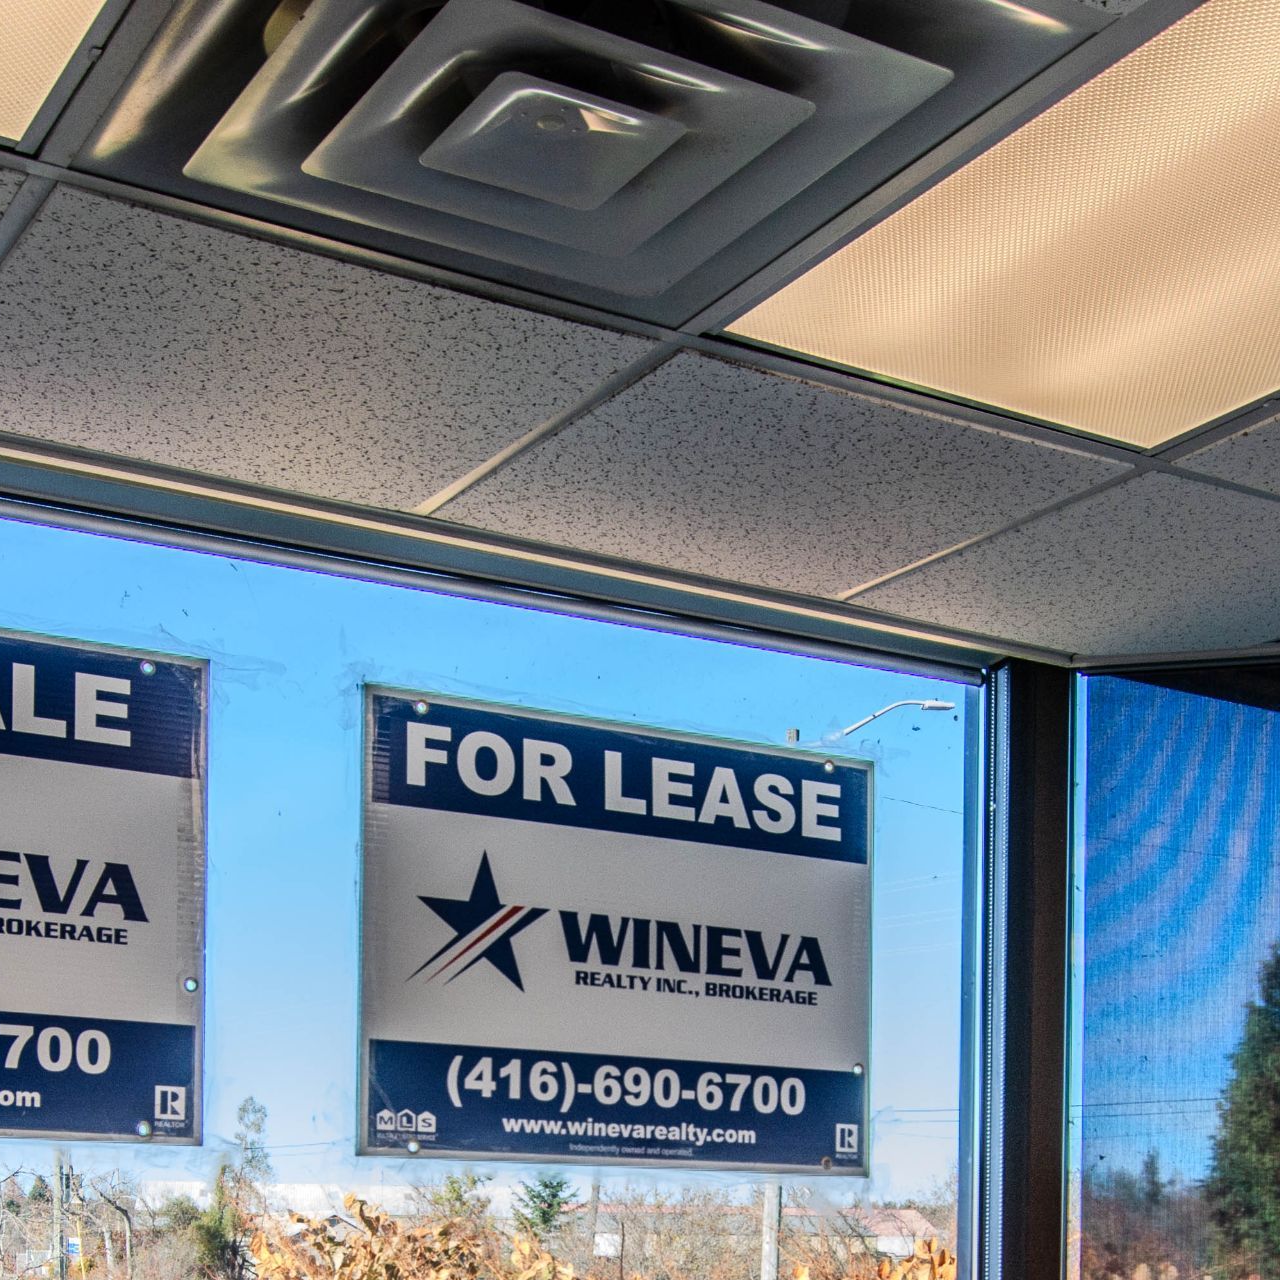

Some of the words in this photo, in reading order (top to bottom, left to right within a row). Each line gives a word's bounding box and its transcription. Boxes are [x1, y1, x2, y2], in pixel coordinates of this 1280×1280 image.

[406, 721, 576, 806] FOR
[604, 750, 841, 842] LEASE
[558, 910, 832, 986] WINEVA
[575, 970, 651, 991] REALTY
[656, 978, 700, 998] INC.,
[705, 982, 818, 1006] BROKERAGE
[447, 1055, 806, 1115] (416)-690-6700
[502, 1117, 756, 1146] www.winevarealty.com
